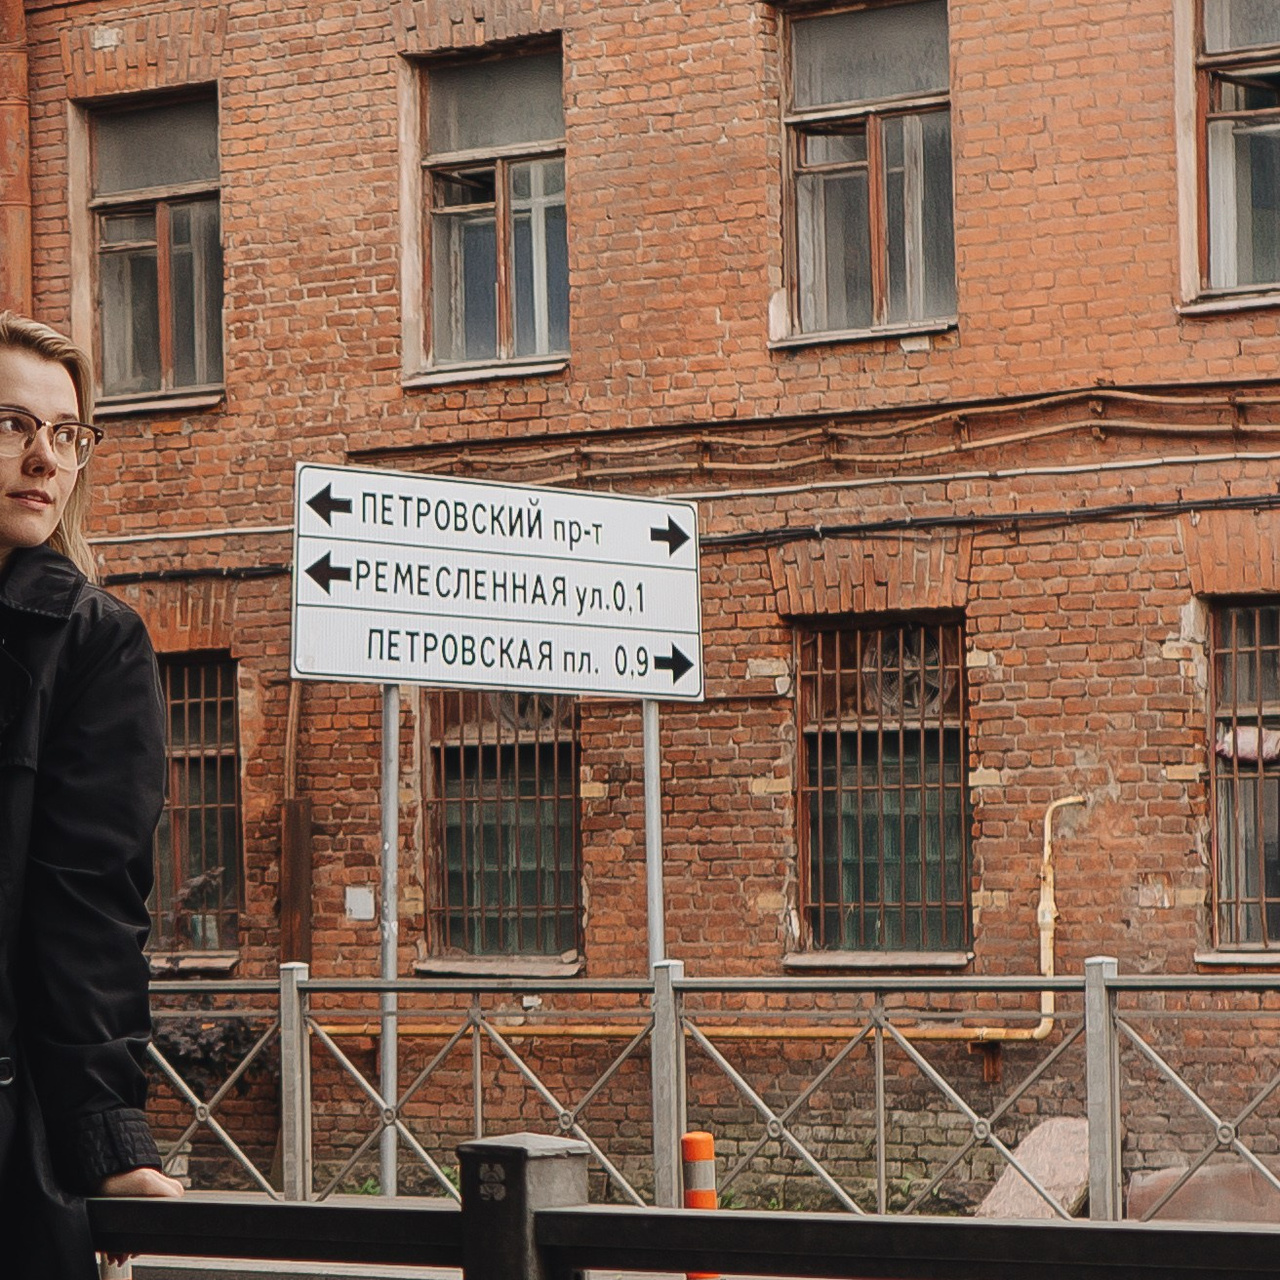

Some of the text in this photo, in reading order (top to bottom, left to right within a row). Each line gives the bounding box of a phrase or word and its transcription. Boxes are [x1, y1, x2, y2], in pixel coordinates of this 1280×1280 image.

[362, 491, 603, 551] ПЕТРОВСКИЙ пр-т
[355, 559, 567, 607] РЕМЕСЛЕННАЯ
[367, 628, 649, 680] ПЕТРОВСКАЯ пл. 0,9
